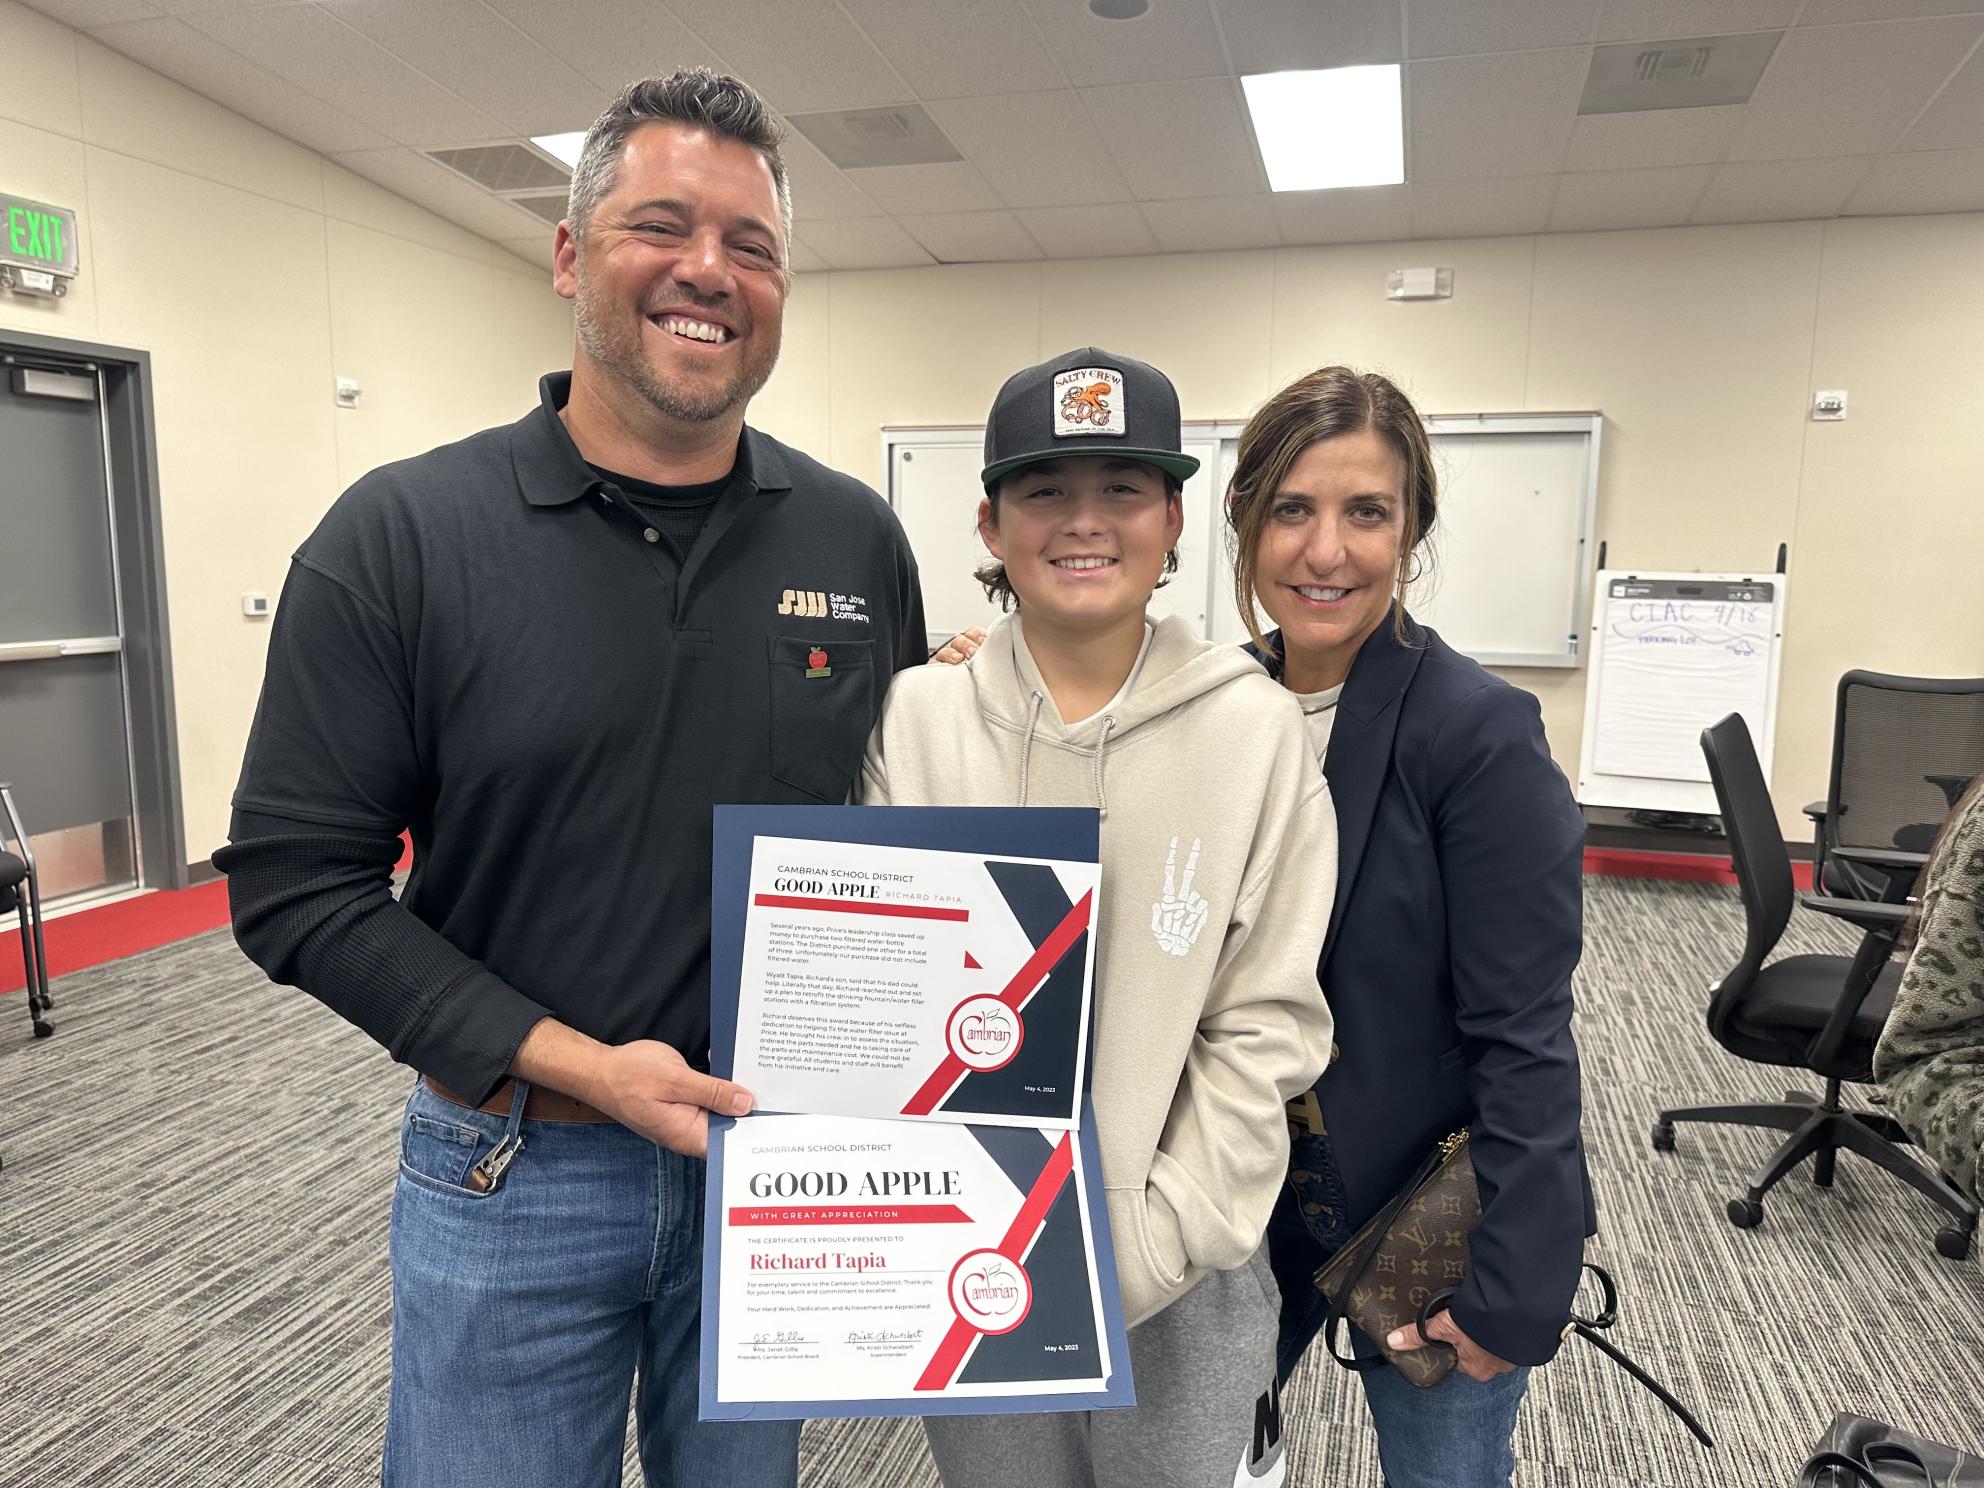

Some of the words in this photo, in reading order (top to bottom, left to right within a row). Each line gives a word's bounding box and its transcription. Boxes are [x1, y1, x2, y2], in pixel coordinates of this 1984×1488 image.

[8, 206, 63, 263] EXIT
[1056, 371, 1086, 387] SALTY
[1089, 370, 1120, 384] CREW
[830, 593, 846, 602] San
[849, 594, 866, 605] Jose
[831, 603, 856, 612] Water
[832, 611, 869, 623] Company
[1630, 602, 1693, 622] CIAC
[1714, 603, 1759, 626] 4/18
[778, 865, 828, 876] CAMBRIAN
[831, 869, 870, 880] SCHOOL
[872, 872, 914, 883] DISTRICT
[774, 878, 823, 894] GOOD
[827, 882, 880, 899] APPLE
[885, 891, 929, 901] RICHARD
[934, 895, 962, 903] TAPIA
[801, 933, 830, 942] purchase
[848, 928, 880, 937] leadership
[833, 944, 866, 952] purchased
[796, 949, 838, 959] Unfortunately
[851, 953, 880, 961] purchase
[782, 981, 806, 989] Literally
[837, 993, 864, 1001] drinking
[804, 1024, 828, 1032] helping
[959, 1010, 1011, 1055] Cambrian
[790, 1031, 815, 1039] brought
[802, 1048, 843, 1056] maintenance
[751, 1145, 805, 1154] CAMBRIAN
[807, 1144, 847, 1153] SCHOOL
[850, 1144, 892, 1152] DISTRICT
[749, 1172, 848, 1198] GOOD
[858, 1170, 962, 1196] APPLE
[750, 1252, 827, 1270] Richard
[832, 1252, 886, 1273] Tapia
[963, 1266, 1018, 1316] Cambrian
